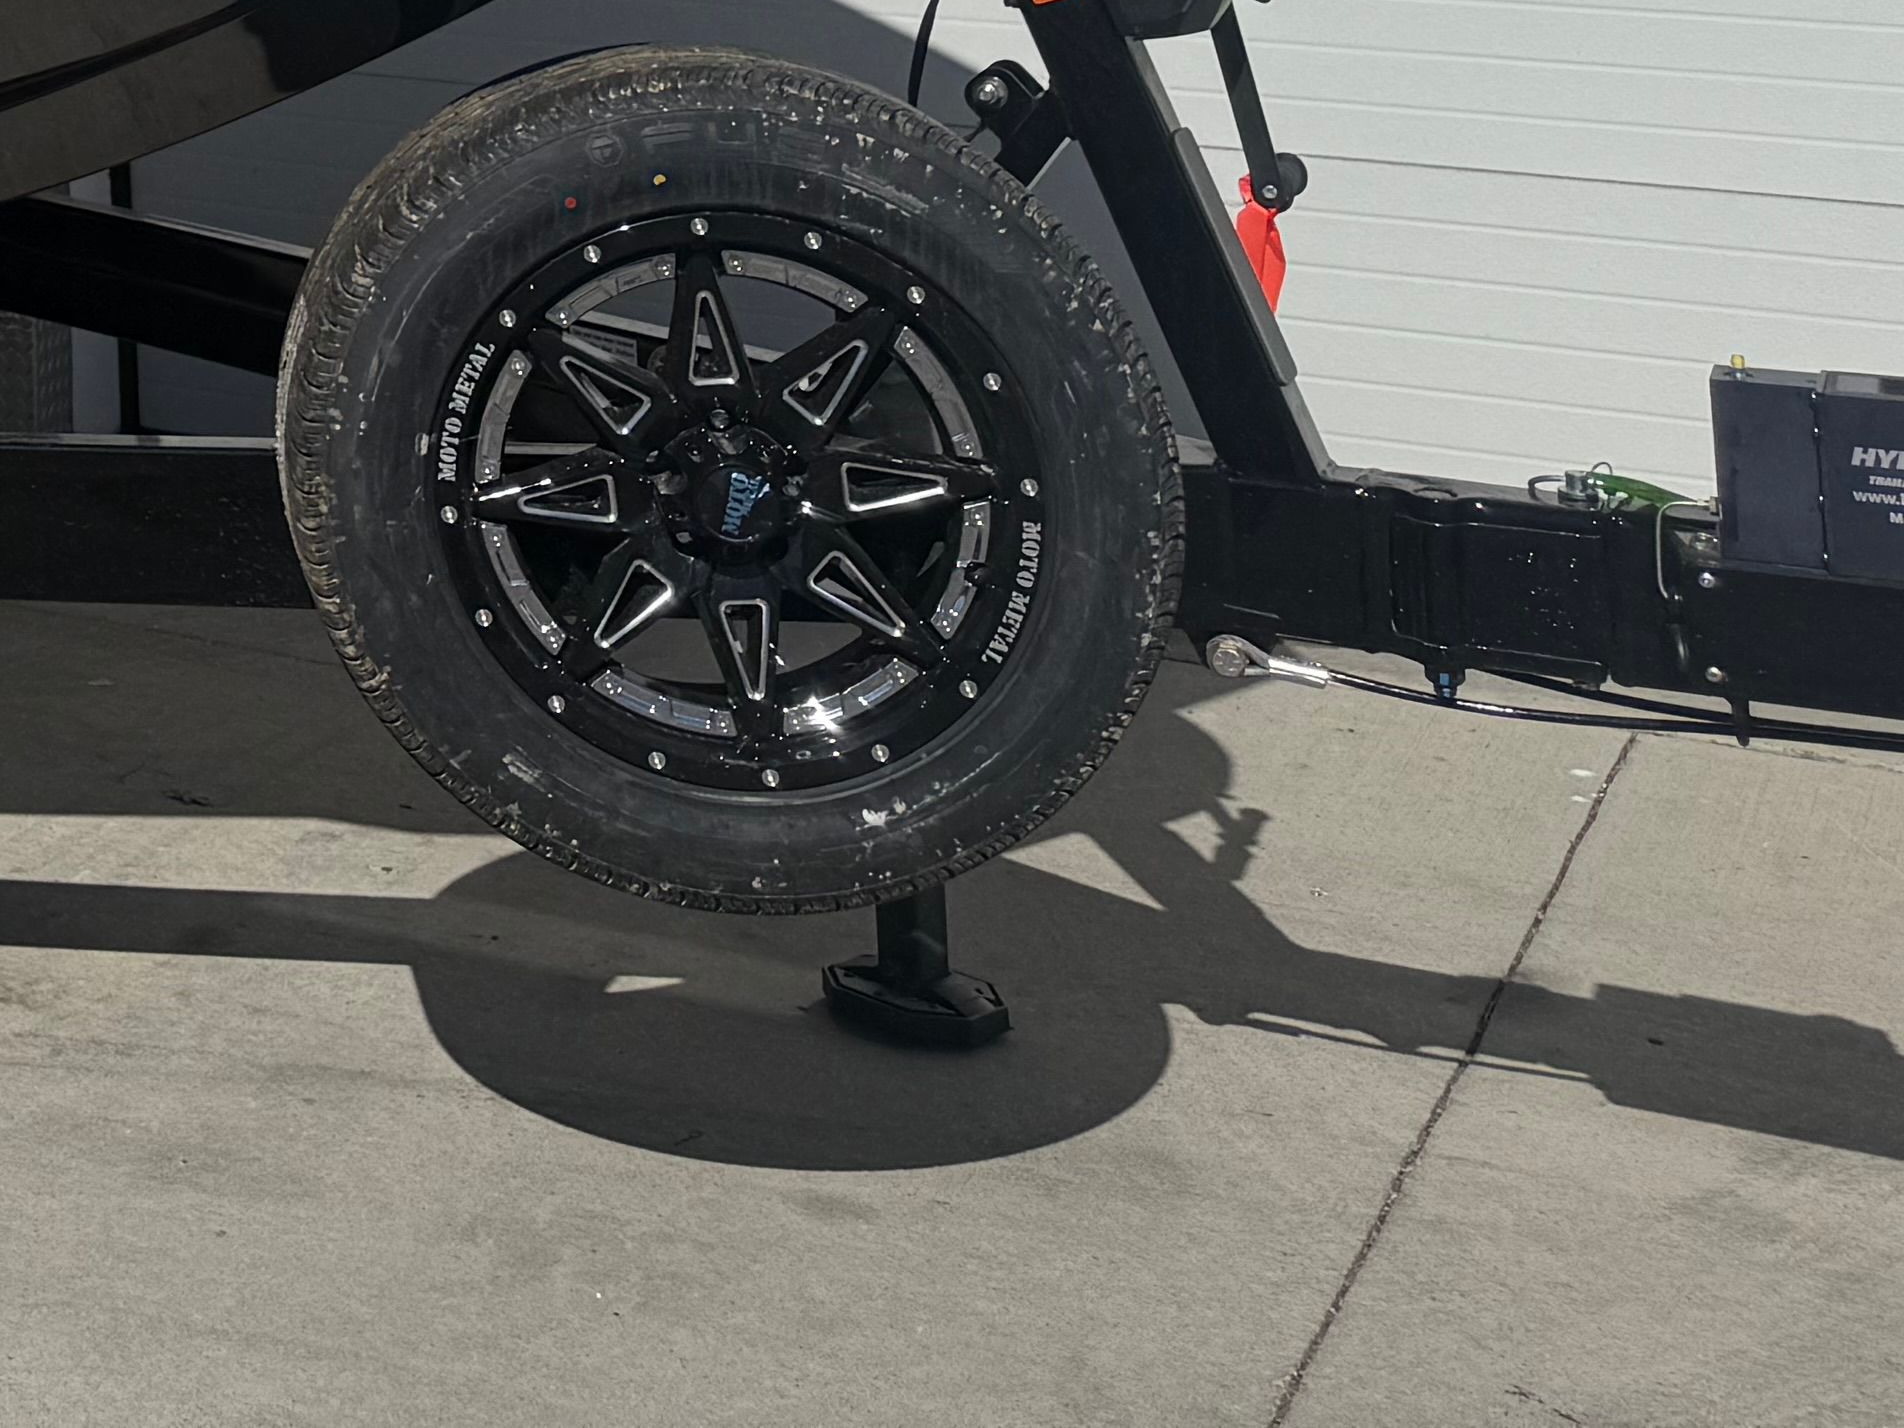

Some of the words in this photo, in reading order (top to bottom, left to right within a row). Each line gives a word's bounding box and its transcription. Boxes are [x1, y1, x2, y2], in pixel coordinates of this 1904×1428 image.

[448, 343, 496, 415] METAL
[438, 417, 463, 482] MOTO
[720, 472, 749, 535] MOTO
[1015, 521, 1042, 588] MOTO
[981, 591, 1031, 664] METAL
